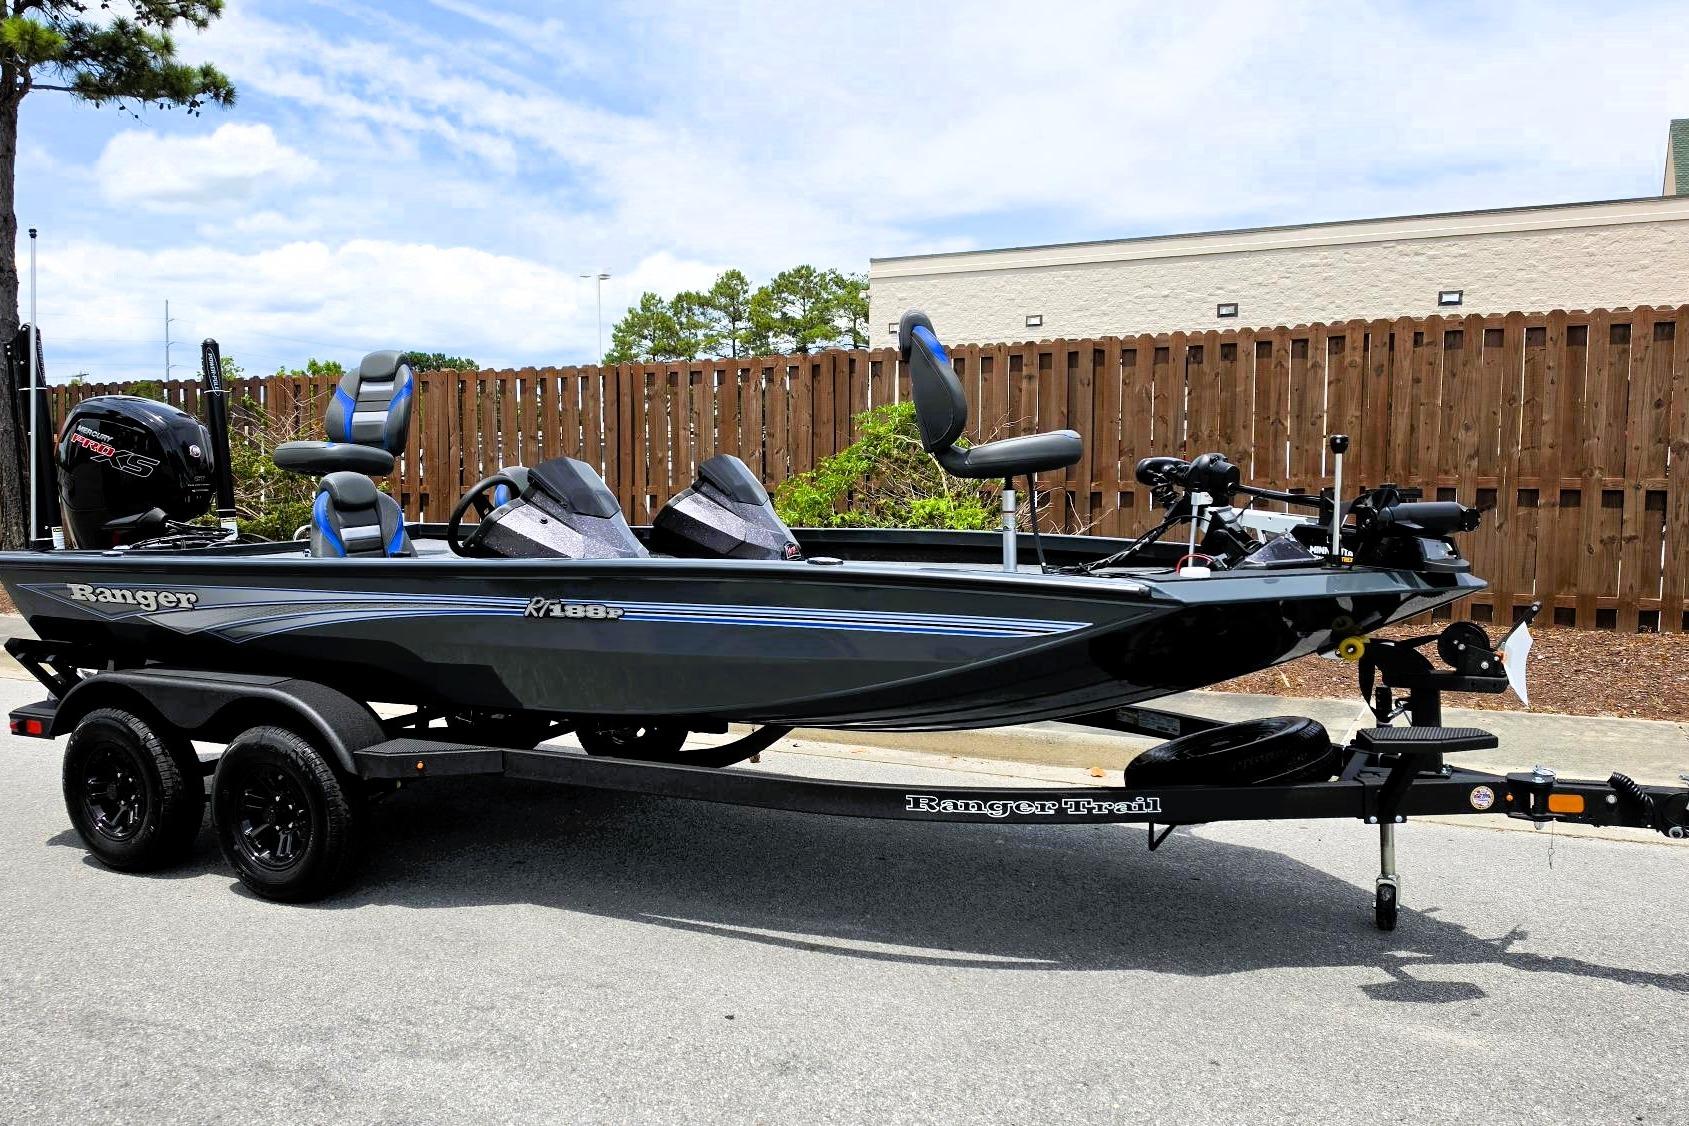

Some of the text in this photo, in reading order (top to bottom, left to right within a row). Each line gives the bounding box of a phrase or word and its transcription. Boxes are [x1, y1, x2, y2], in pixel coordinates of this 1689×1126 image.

[77, 425, 114, 442] MERCURY
[71, 433, 160, 477] PRO XS
[66, 583, 198, 612] Ranger
[905, 794, 1162, 817] Ranger Trail
